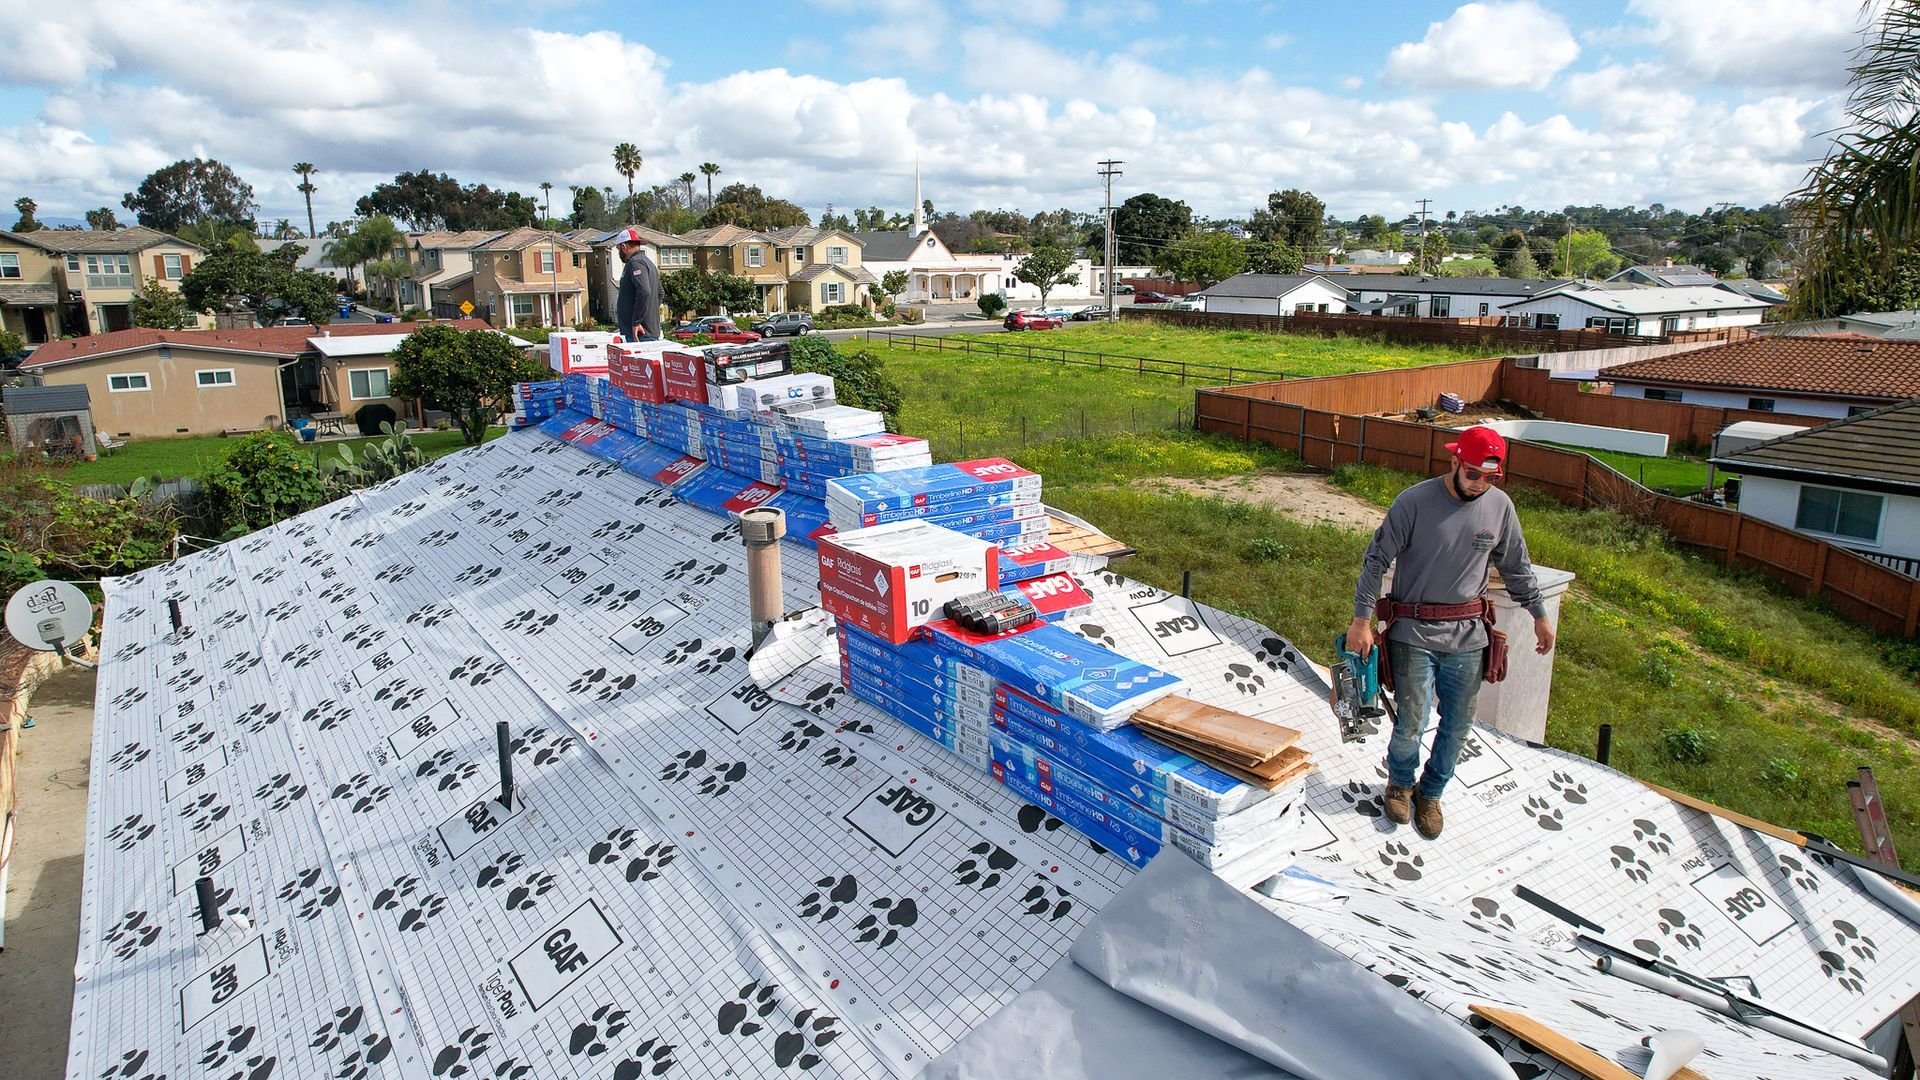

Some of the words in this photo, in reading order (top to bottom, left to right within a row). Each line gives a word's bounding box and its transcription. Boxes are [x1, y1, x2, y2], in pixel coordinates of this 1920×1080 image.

[665, 460, 696, 475] GAF
[973, 464, 1018, 477] GAF
[736, 487, 771, 503] GAF
[914, 496, 926, 504] GAF
[928, 489, 961, 501] Timberline
[879, 510, 914, 522] Timberline
[929, 505, 938, 513] RS
[940, 519, 962, 528] berline
[1004, 541, 1051, 557] GAF
[821, 555, 834, 569] GAF
[910, 568, 920, 576] GAF
[921, 559, 953, 573] Ridglass
[561, 567, 587, 584] GAF
[27, 591, 58, 608] dish
[1028, 576, 1075, 600] GAF
[1130, 587, 1159, 600] rPaw
[632, 616, 665, 637] GAF
[1154, 615, 1199, 638] GAF
[848, 633, 873, 652] Timberline
[924, 629, 933, 638] GAF
[976, 653, 986, 665] RS
[731, 683, 773, 712] GAF
[994, 713, 1004, 723] GAF
[995, 693, 1006, 704] GAF
[1008, 697, 1045, 723] Timberline
[1060, 724, 1071, 736] RS
[411, 715, 437, 739] GAF
[186, 763, 206, 785] GAF
[1038, 762, 1049, 773] GAF
[993, 766, 1003, 777] GAF
[1006, 772, 1042, 800] Timberline
[1471, 780, 1519, 804] TigerPaw
[875, 785, 937, 826] GAF
[1041, 780, 1052, 792] GAF
[1055, 786, 1093, 817] Timberline
[465, 801, 499, 834] GAF
[197, 846, 221, 876] GAF
[417, 832, 440, 868] TigerPaw
[1681, 846, 1723, 873] TigerPaw
[1724, 887, 1766, 921] GAF
[275, 928, 292, 969] TigerPaw
[544, 928, 589, 974] GAF
[210, 963, 239, 1004] GAF
[485, 968, 518, 1020] TigerPaw
